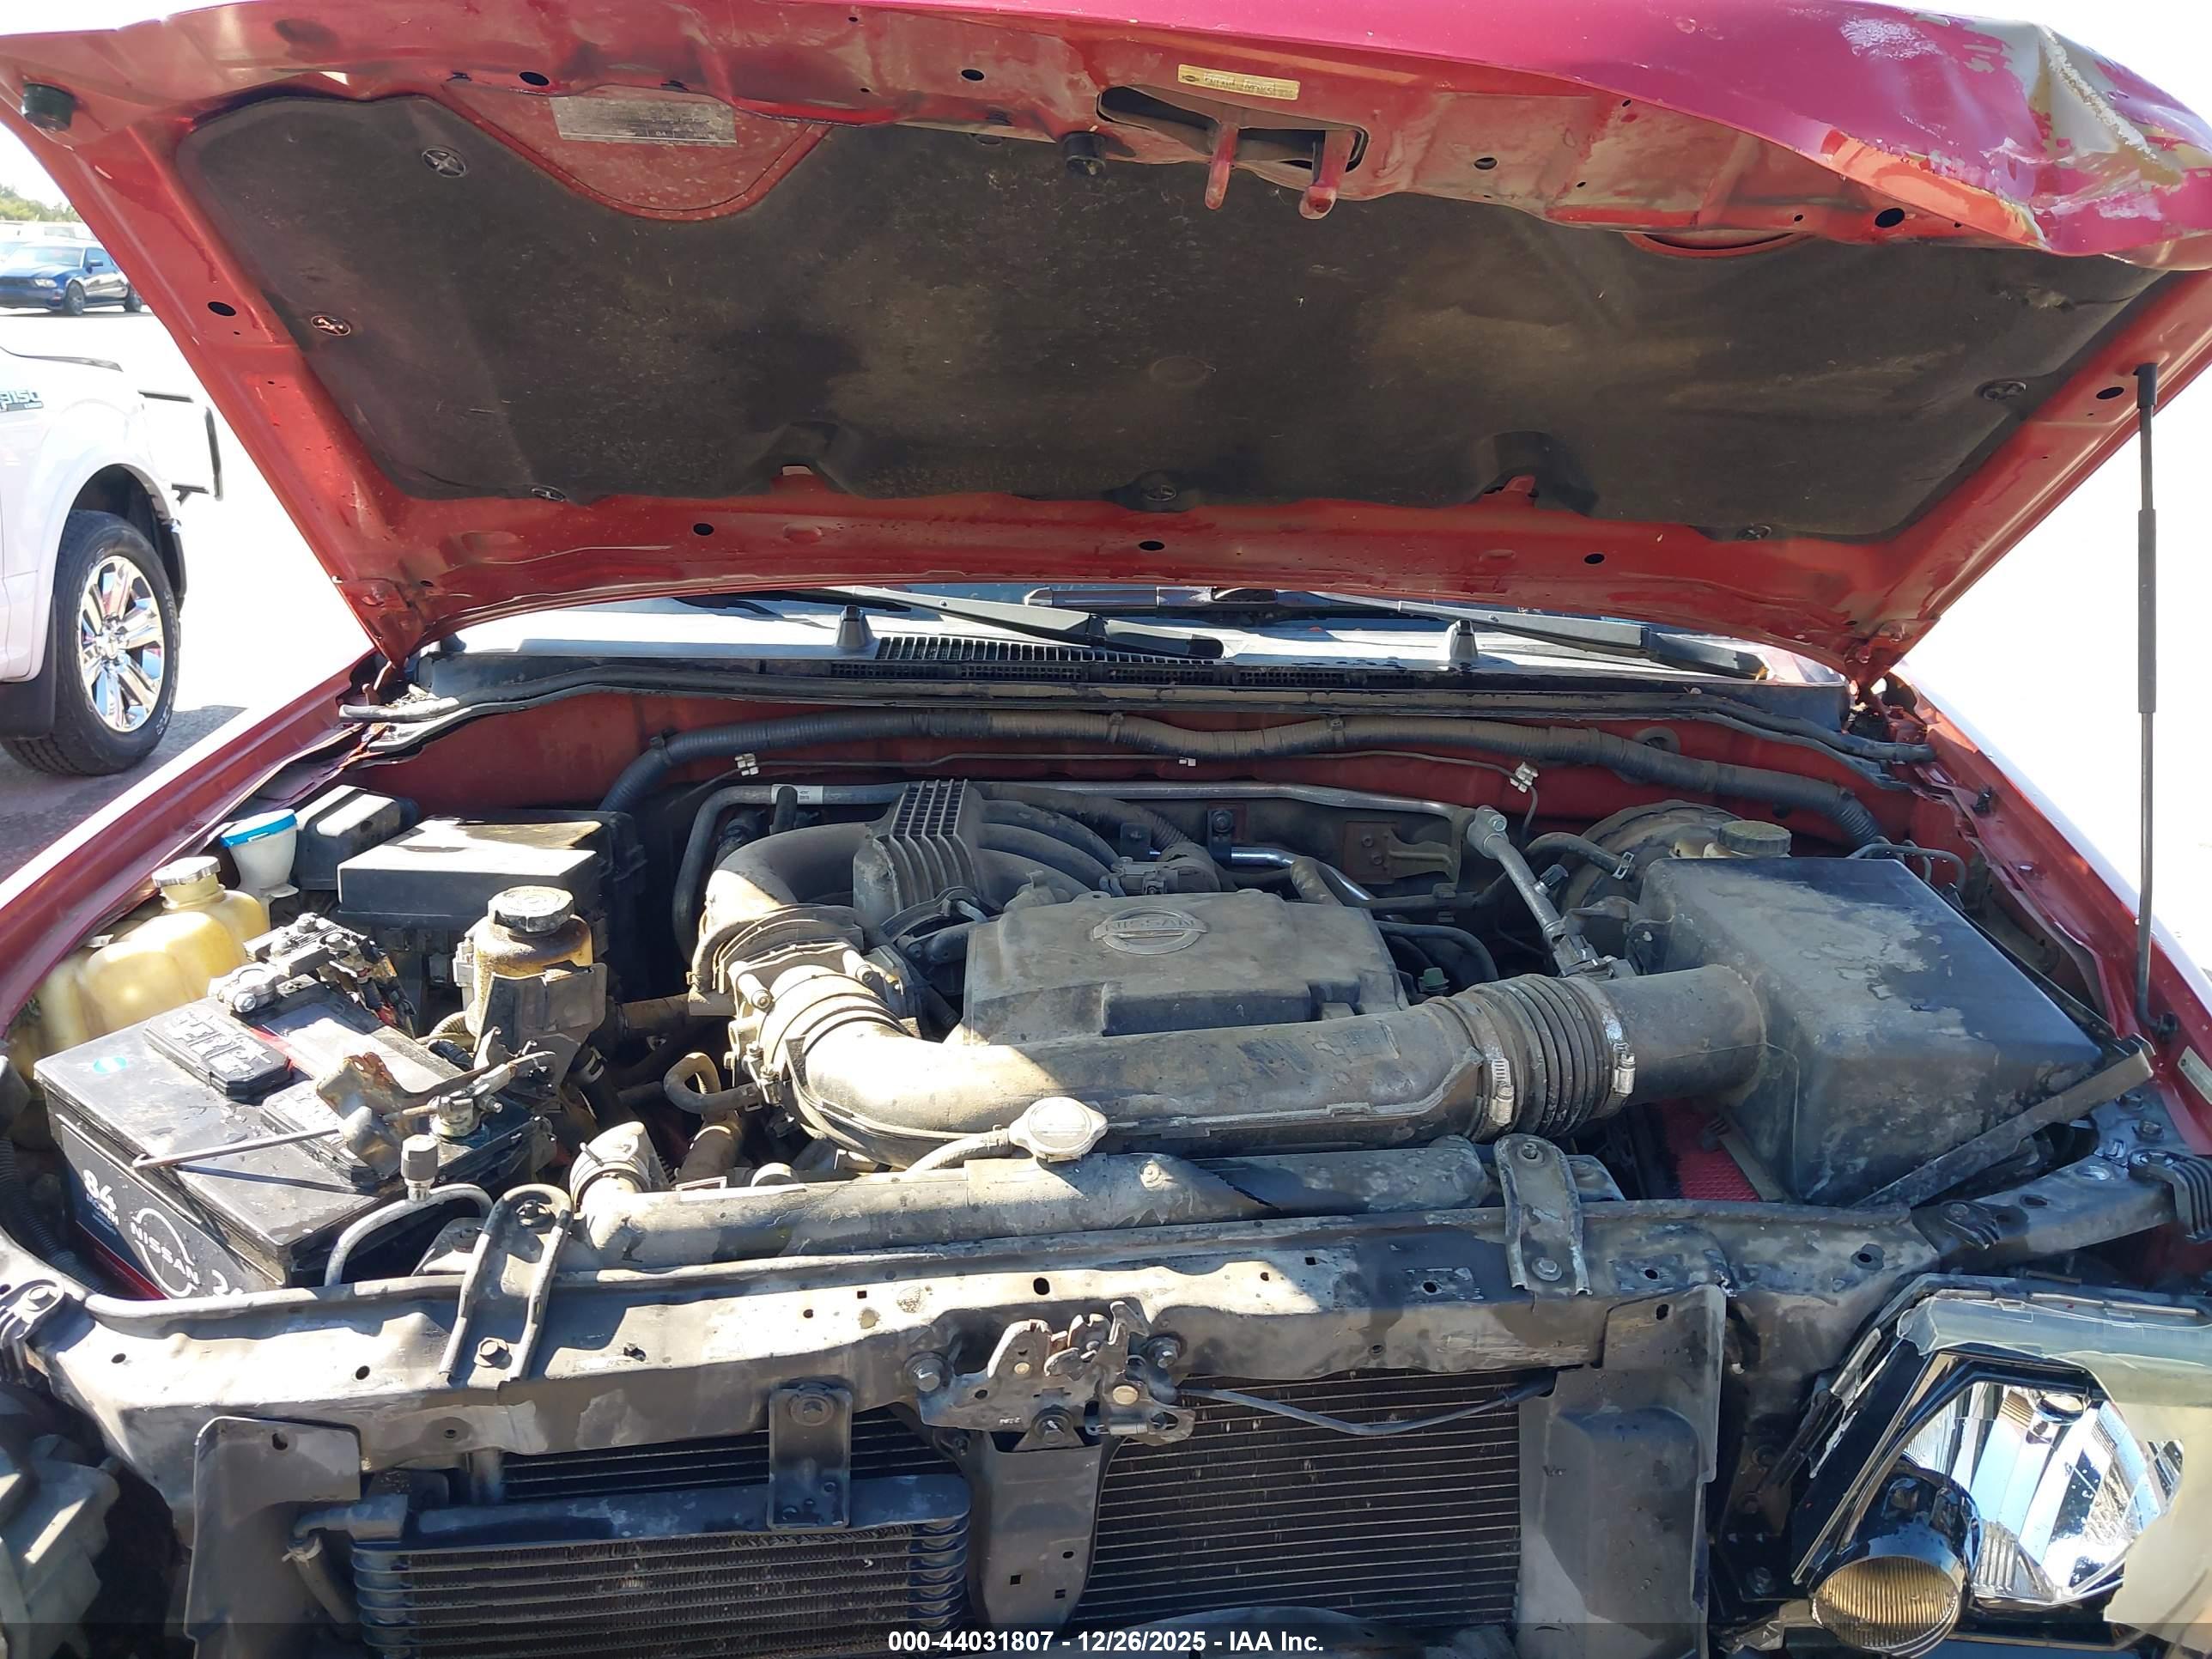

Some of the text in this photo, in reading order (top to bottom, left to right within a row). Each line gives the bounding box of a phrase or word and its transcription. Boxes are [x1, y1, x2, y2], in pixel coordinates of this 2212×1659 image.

[1104, 918, 1196, 933] NISSAN
[82, 1169, 118, 1212] 84
[86, 1193, 119, 1226] MONTH
[130, 1221, 201, 1285] NISSAN
